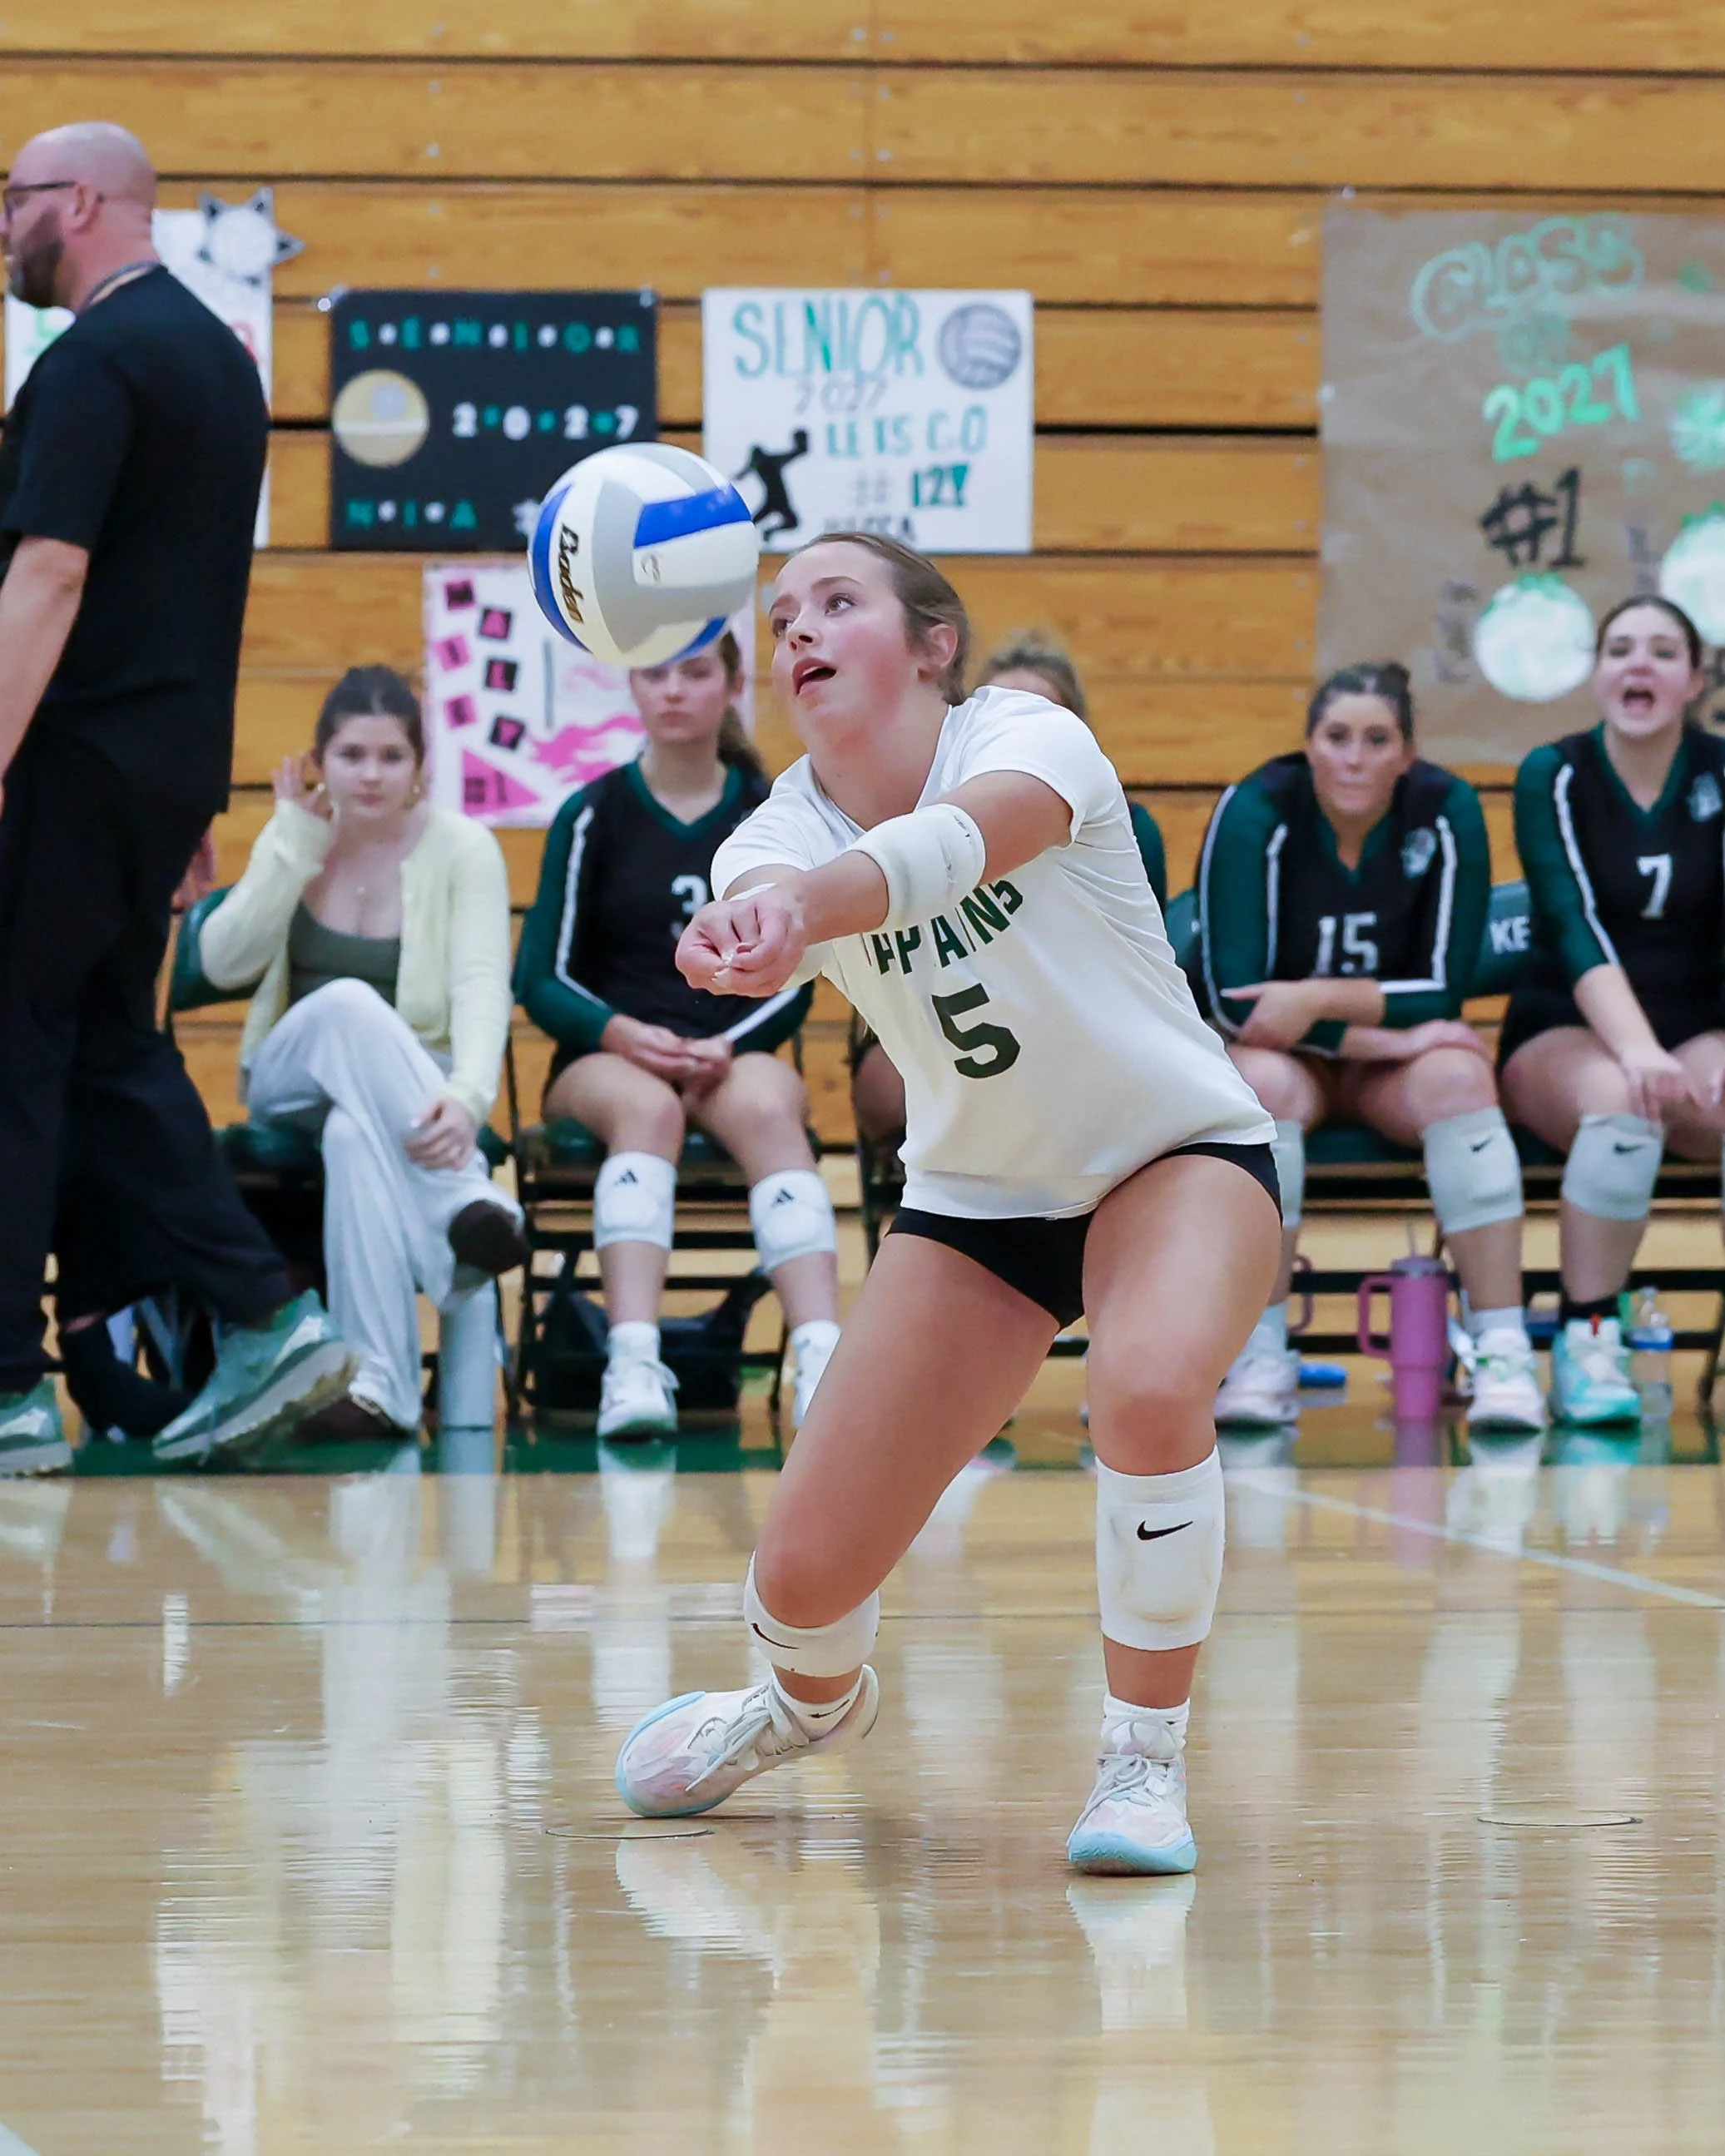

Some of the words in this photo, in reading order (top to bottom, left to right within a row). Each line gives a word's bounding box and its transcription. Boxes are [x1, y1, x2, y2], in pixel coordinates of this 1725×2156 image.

[1481, 343, 1641, 463] 2027
[1480, 468, 1585, 569] #1
[1637, 853, 1673, 918] 7
[1315, 912, 1380, 975] 15
[931, 982, 1021, 1079] 5
